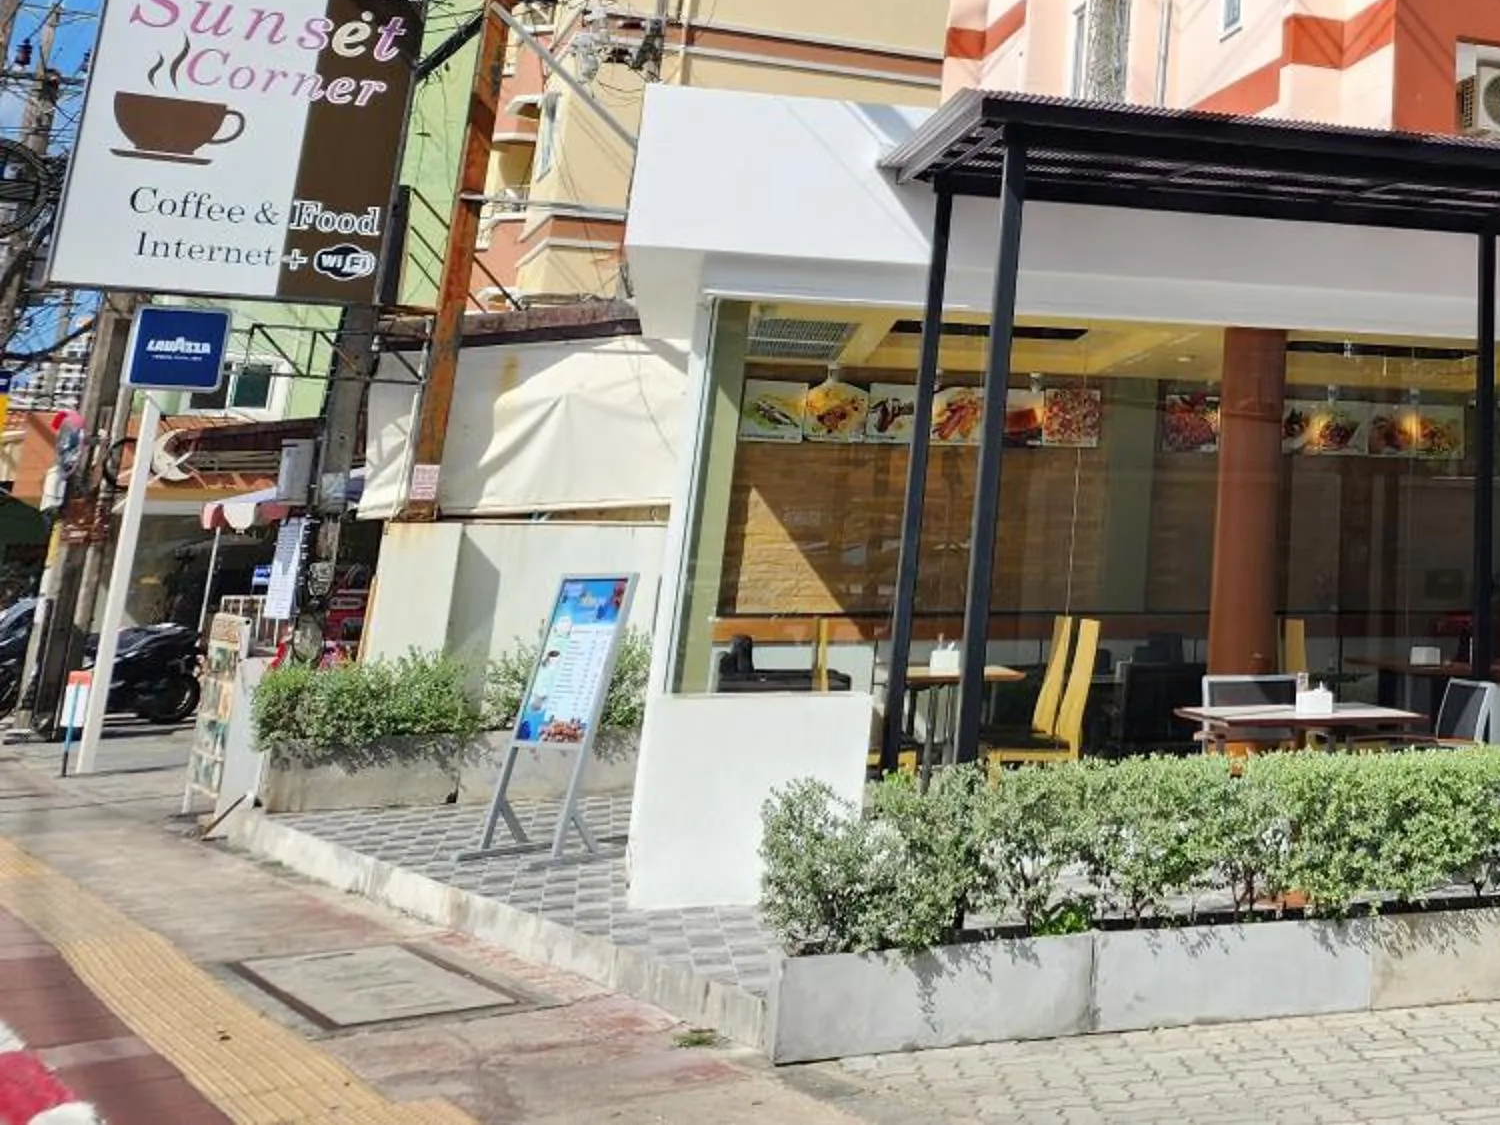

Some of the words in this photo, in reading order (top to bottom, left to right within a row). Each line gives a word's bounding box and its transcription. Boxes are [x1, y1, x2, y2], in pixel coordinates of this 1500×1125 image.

[186, 48, 388, 107] Corner
[129, 186, 246, 224] Coffee
[254, 200, 279, 226] &
[290, 199, 382, 236] Food
[134, 230, 277, 268] Internet
[146, 336, 211, 355] LAVAZZA
